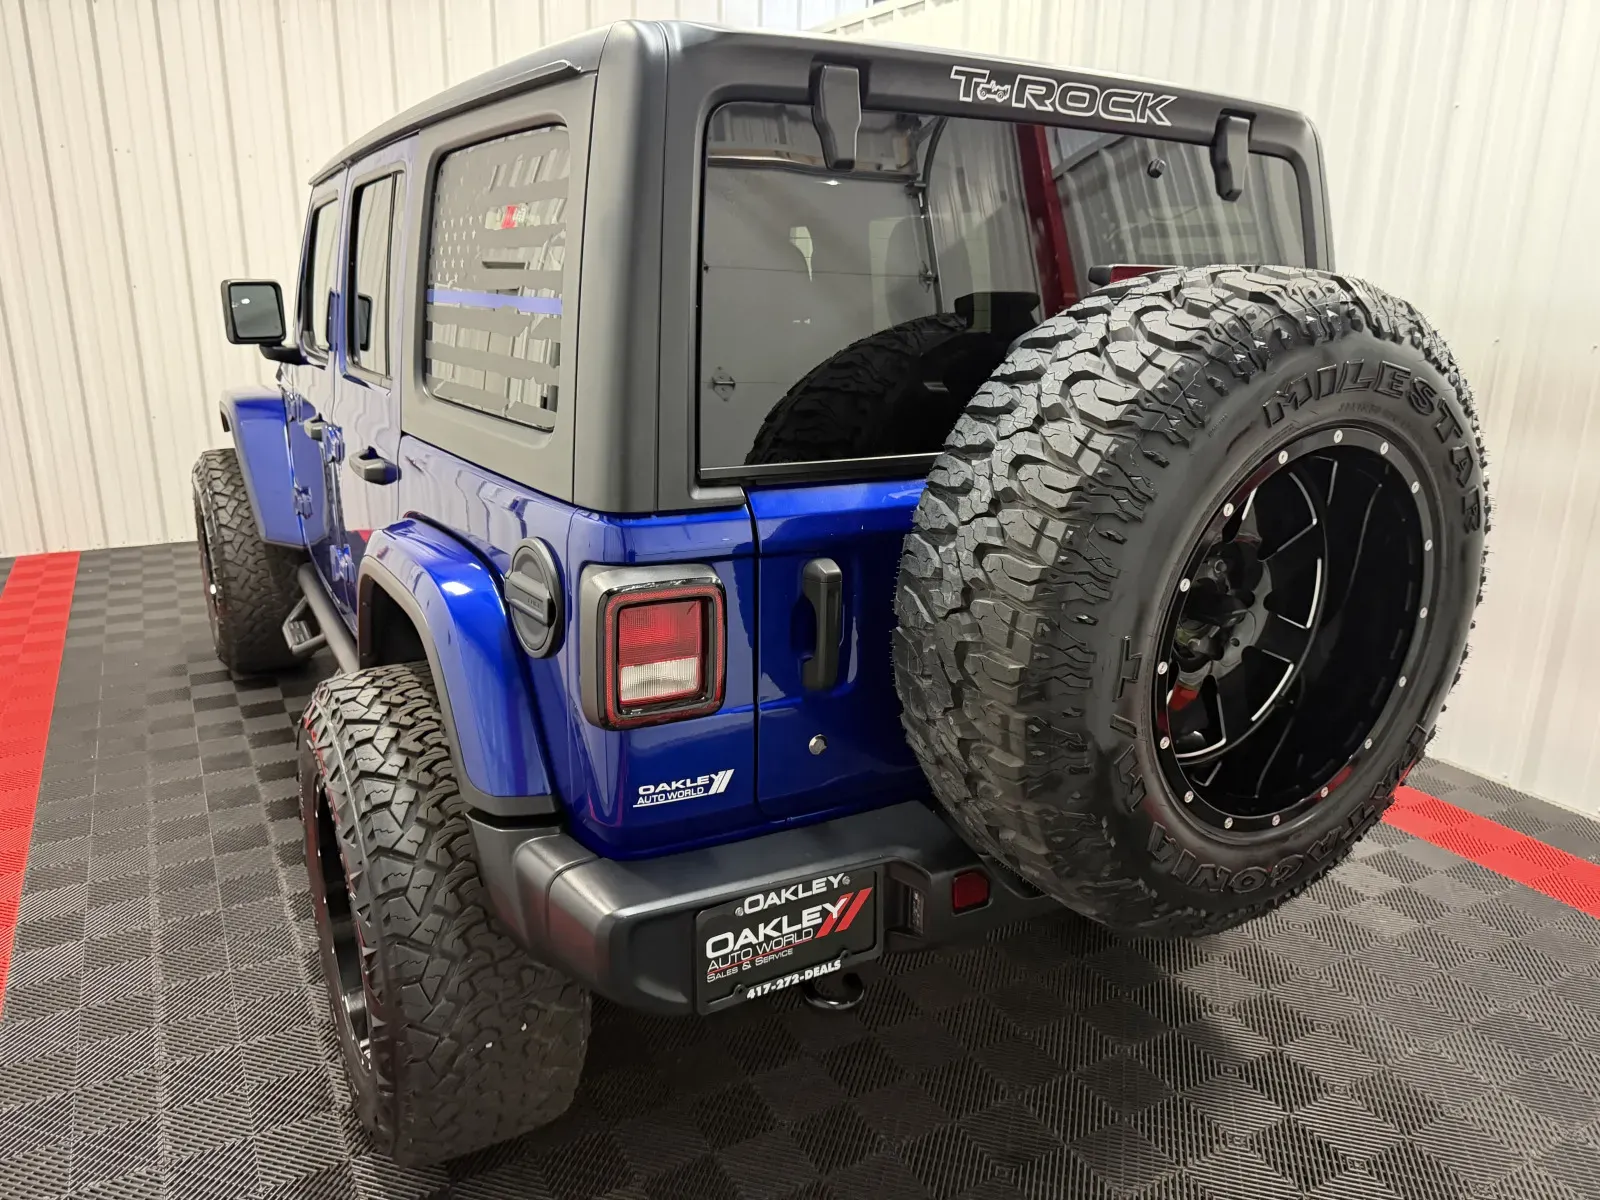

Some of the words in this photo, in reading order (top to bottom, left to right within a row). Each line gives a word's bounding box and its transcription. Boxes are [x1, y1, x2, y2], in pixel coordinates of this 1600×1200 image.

[1261, 358, 1483, 536] MILESTAR
[636, 792, 666, 806] AUTO
[667, 785, 704, 801] WORLD
[638, 773, 722, 796] OAKLEY
[743, 872, 846, 916] OAKLEY
[705, 897, 849, 960] OAKLEY
[707, 947, 753, 973] AUTO
[756, 927, 814, 955] WORLD
[707, 965, 739, 983] SALES
[742, 960, 752, 971] &
[755, 948, 794, 966] SERVICE
[747, 959, 842, 1000] 417-272-DEALS
